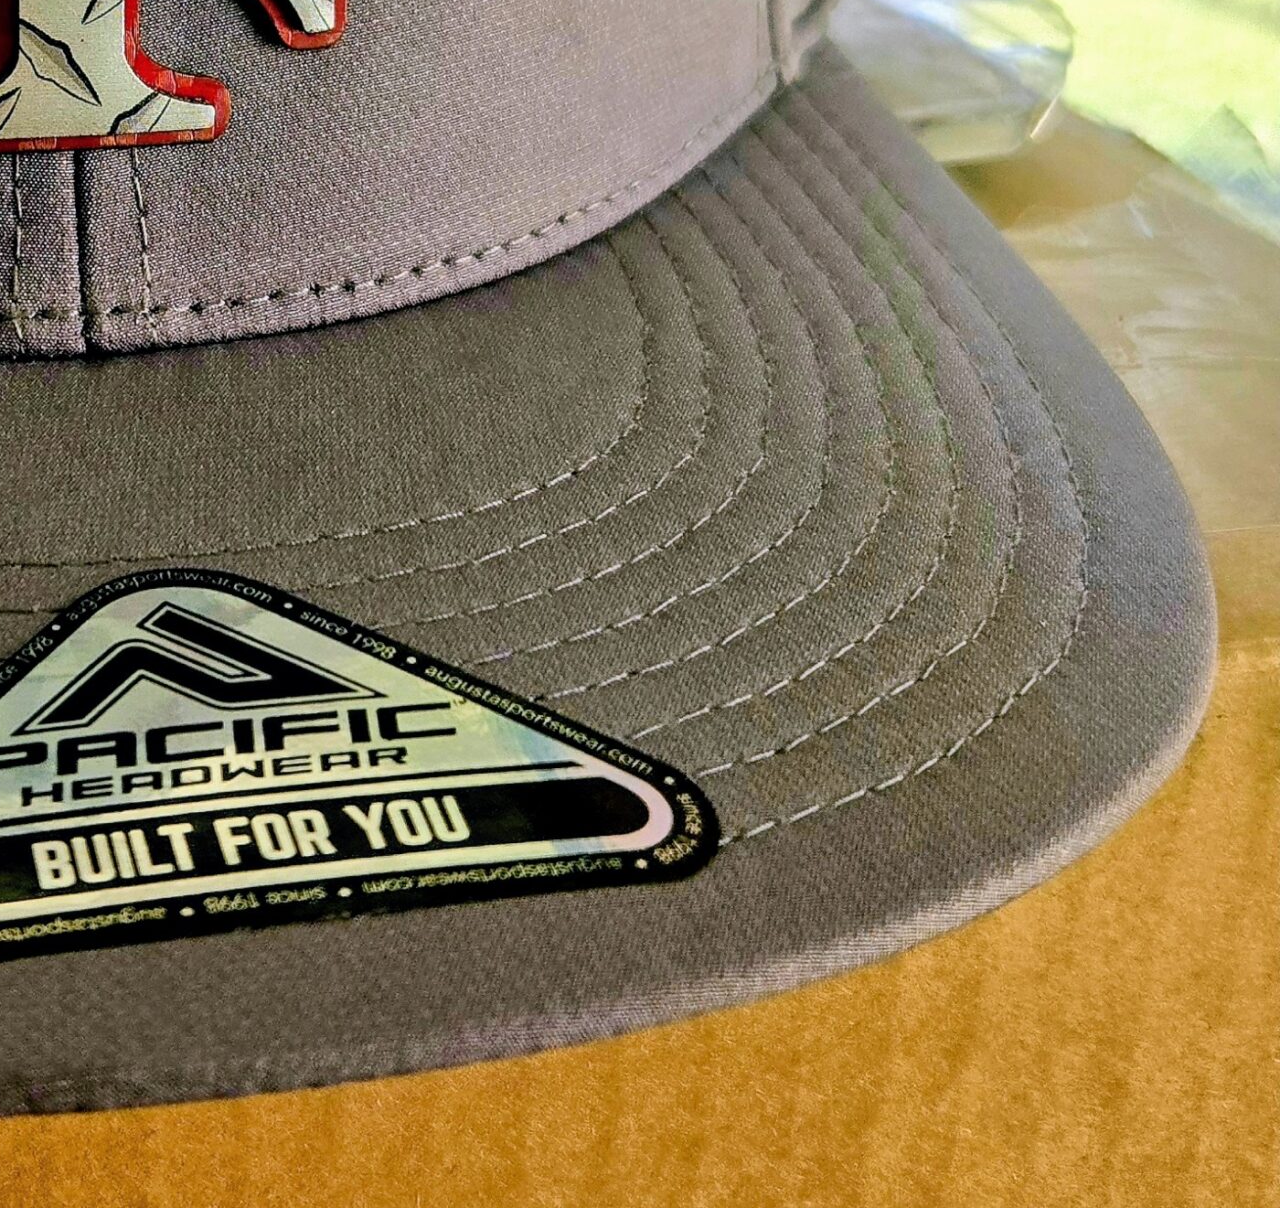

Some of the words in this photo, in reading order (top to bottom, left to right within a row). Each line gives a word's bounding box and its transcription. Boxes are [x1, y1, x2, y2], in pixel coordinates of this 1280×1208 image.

[67, 570, 272, 621] augustasportswear.com
[16, 636, 54, 664] 1998
[300, 609, 348, 637] since
[352, 631, 397, 660] 1998
[424, 664, 654, 776] augustasportswear.com
[21, 747, 408, 807] HEADWEAR
[31, 823, 195, 891] BUILT
[213, 808, 338, 866] FOR
[342, 795, 471, 850] YOU
[203, 892, 260, 915] 1998
[265, 885, 327, 905] since
